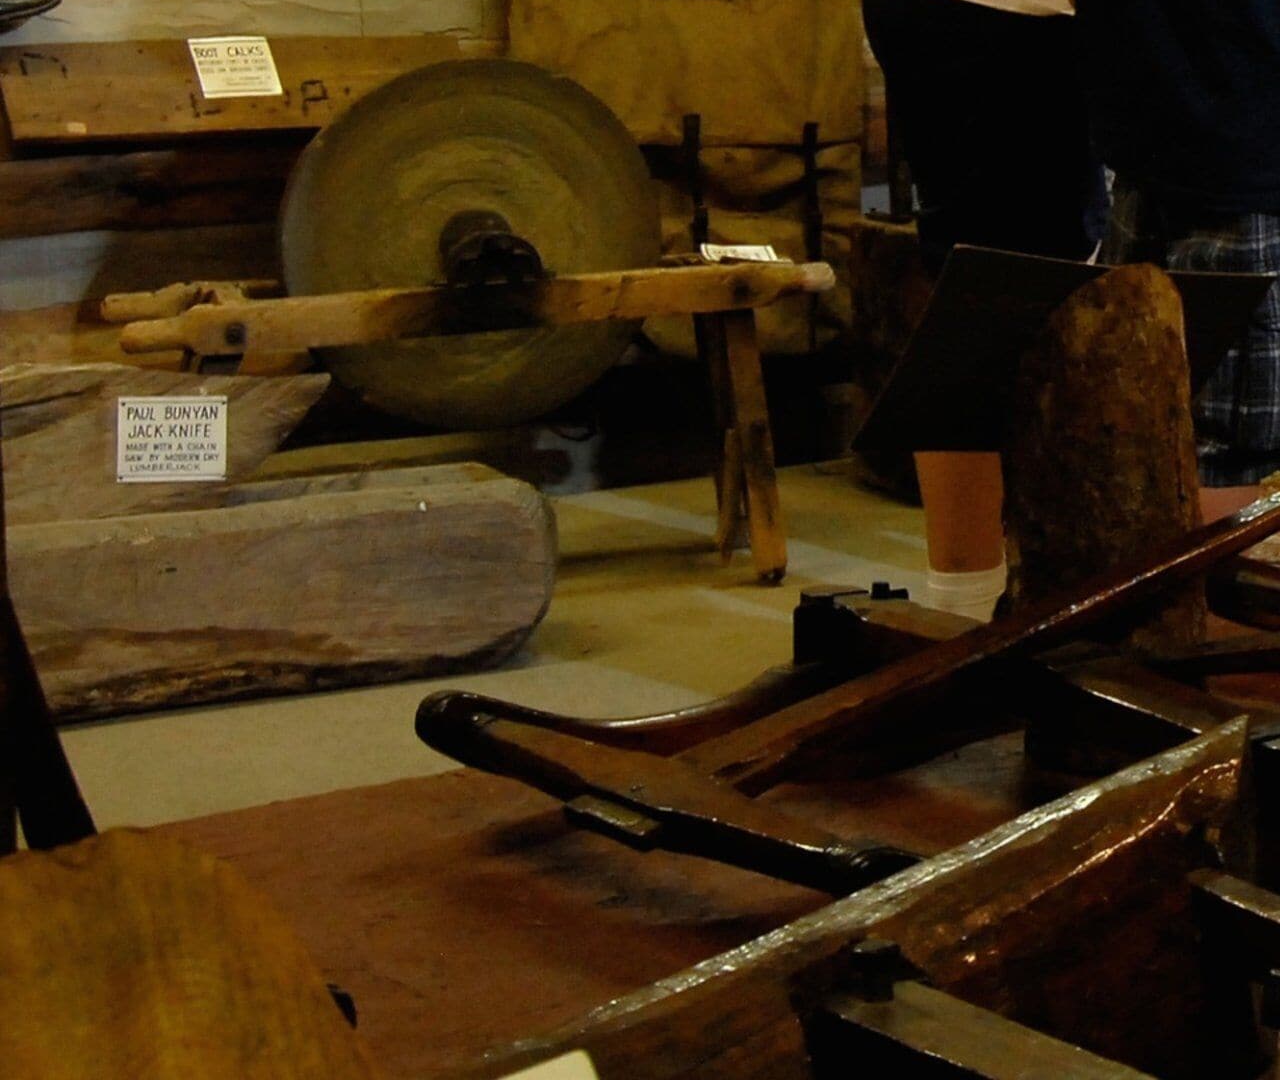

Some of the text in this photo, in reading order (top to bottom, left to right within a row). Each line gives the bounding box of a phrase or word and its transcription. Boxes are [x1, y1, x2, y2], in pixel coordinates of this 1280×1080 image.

[194, 47, 218, 58] BOOT
[127, 405, 218, 420] PAUL BUNYAN
[153, 443, 172, 451] WITH
[177, 443, 183, 451] A
[187, 443, 217, 451] CHAIN
[149, 454, 159, 462] BY
